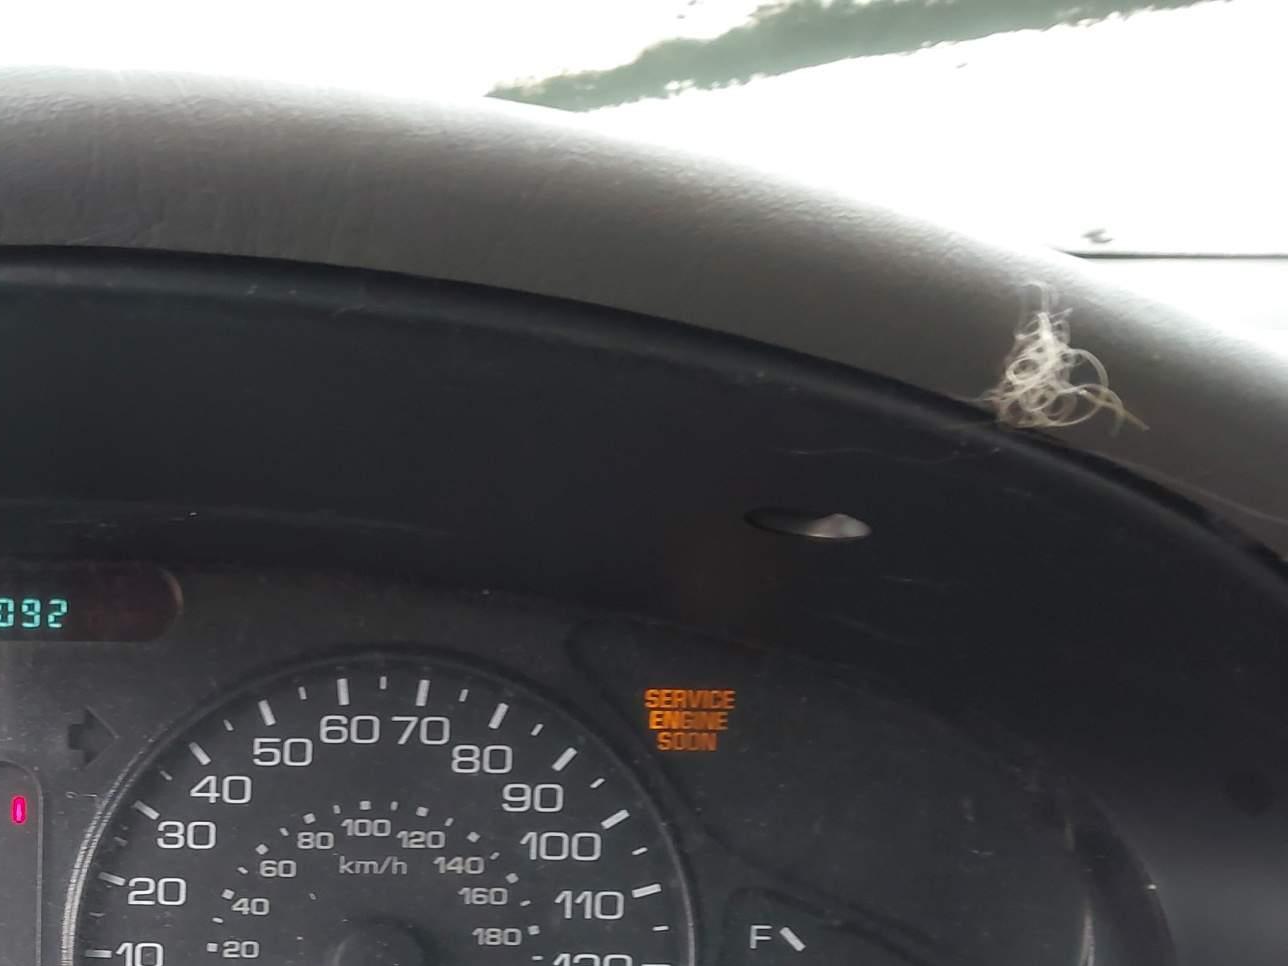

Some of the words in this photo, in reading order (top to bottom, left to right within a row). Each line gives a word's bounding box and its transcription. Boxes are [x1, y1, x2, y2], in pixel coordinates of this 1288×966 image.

[644, 689, 735, 709] SERVICE
[320, 716, 379, 743] 60
[649, 710, 729, 730] ENGINE
[392, 717, 449, 744] 70
[657, 732, 718, 751] SOON
[254, 738, 312, 766] 50
[452, 745, 512, 773] 80
[190, 776, 251, 803] 40
[502, 784, 563, 812] 90
[158, 821, 216, 849] 30
[341, 819, 390, 836] 100
[298, 832, 333, 849] 80
[397, 831, 445, 848] 120
[520, 832, 601, 860] 100
[260, 860, 296, 877] 60
[339, 856, 407, 874] km/h
[434, 857, 484, 874] 140
[128, 878, 186, 905] 20
[458, 888, 507, 904] 160
[232, 898, 269, 915] 40
[555, 891, 624, 919] 110
[472, 928, 521, 945] 180
[750, 926, 772, 948] F
[223, 941, 259, 958] 20
